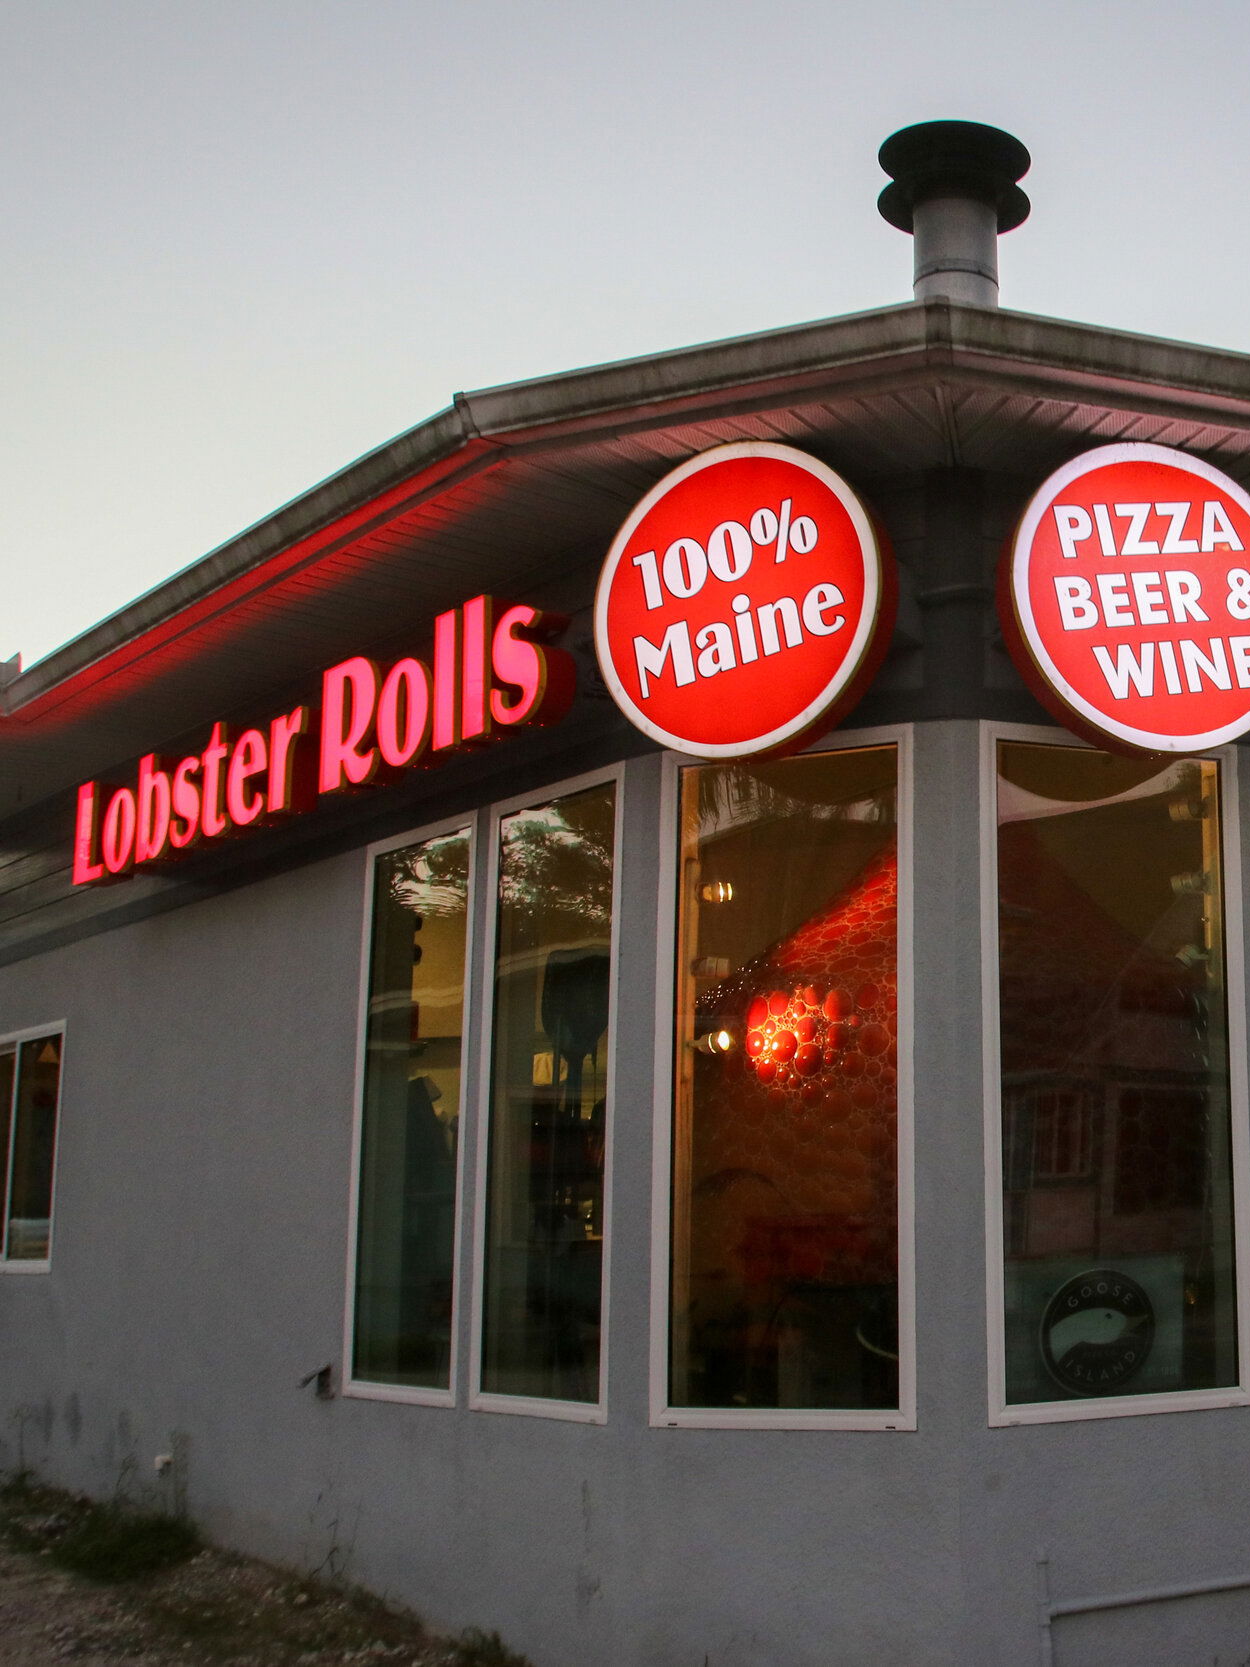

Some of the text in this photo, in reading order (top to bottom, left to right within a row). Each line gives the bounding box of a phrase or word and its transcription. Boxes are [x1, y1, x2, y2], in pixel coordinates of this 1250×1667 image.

[632, 497, 818, 610] 100%
[1052, 500, 1245, 559] PIZZA
[1053, 570, 1210, 631] BEER
[632, 582, 846, 699] Maine
[72, 594, 543, 885] Lobster Rolls
[1067, 1282, 1133, 1308] GOOSE
[1065, 1351, 1135, 1382] ISLAND
